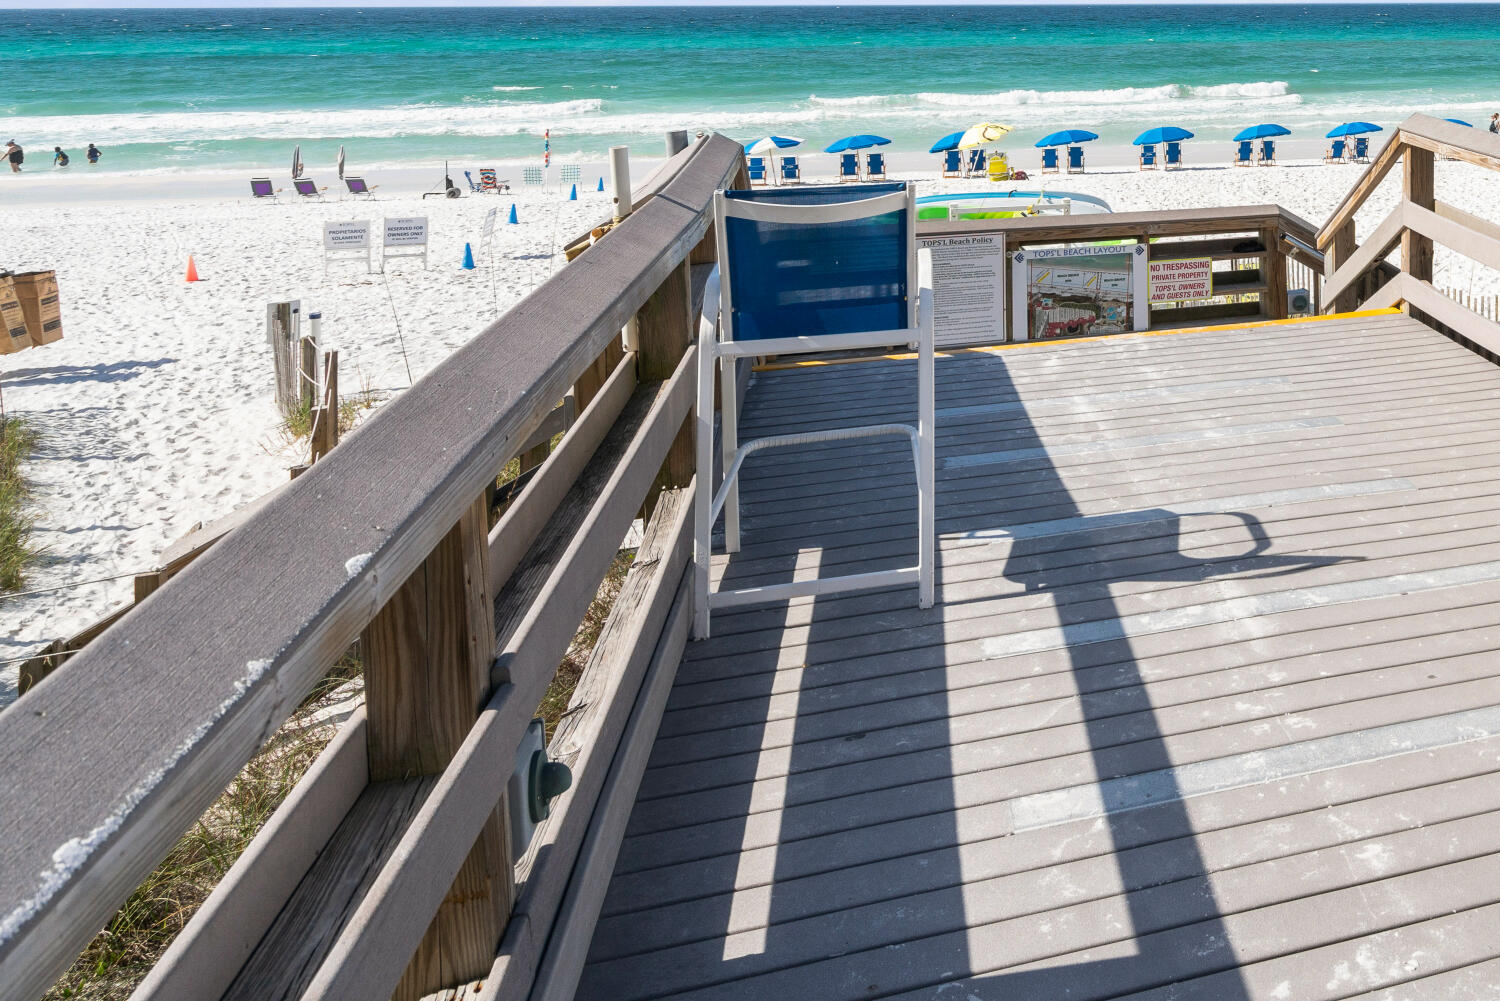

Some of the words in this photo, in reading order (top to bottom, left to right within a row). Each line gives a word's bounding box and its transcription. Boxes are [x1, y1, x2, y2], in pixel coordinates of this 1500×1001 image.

[922, 239, 947, 247] TOPS'L
[1033, 250, 1061, 258] TOPS'L
[1063, 248, 1091, 257] BEACH
[1094, 246, 1127, 254] LAYOUT
[1150, 264, 1160, 272] NO
[1162, 261, 1210, 271] TRESPASSING
